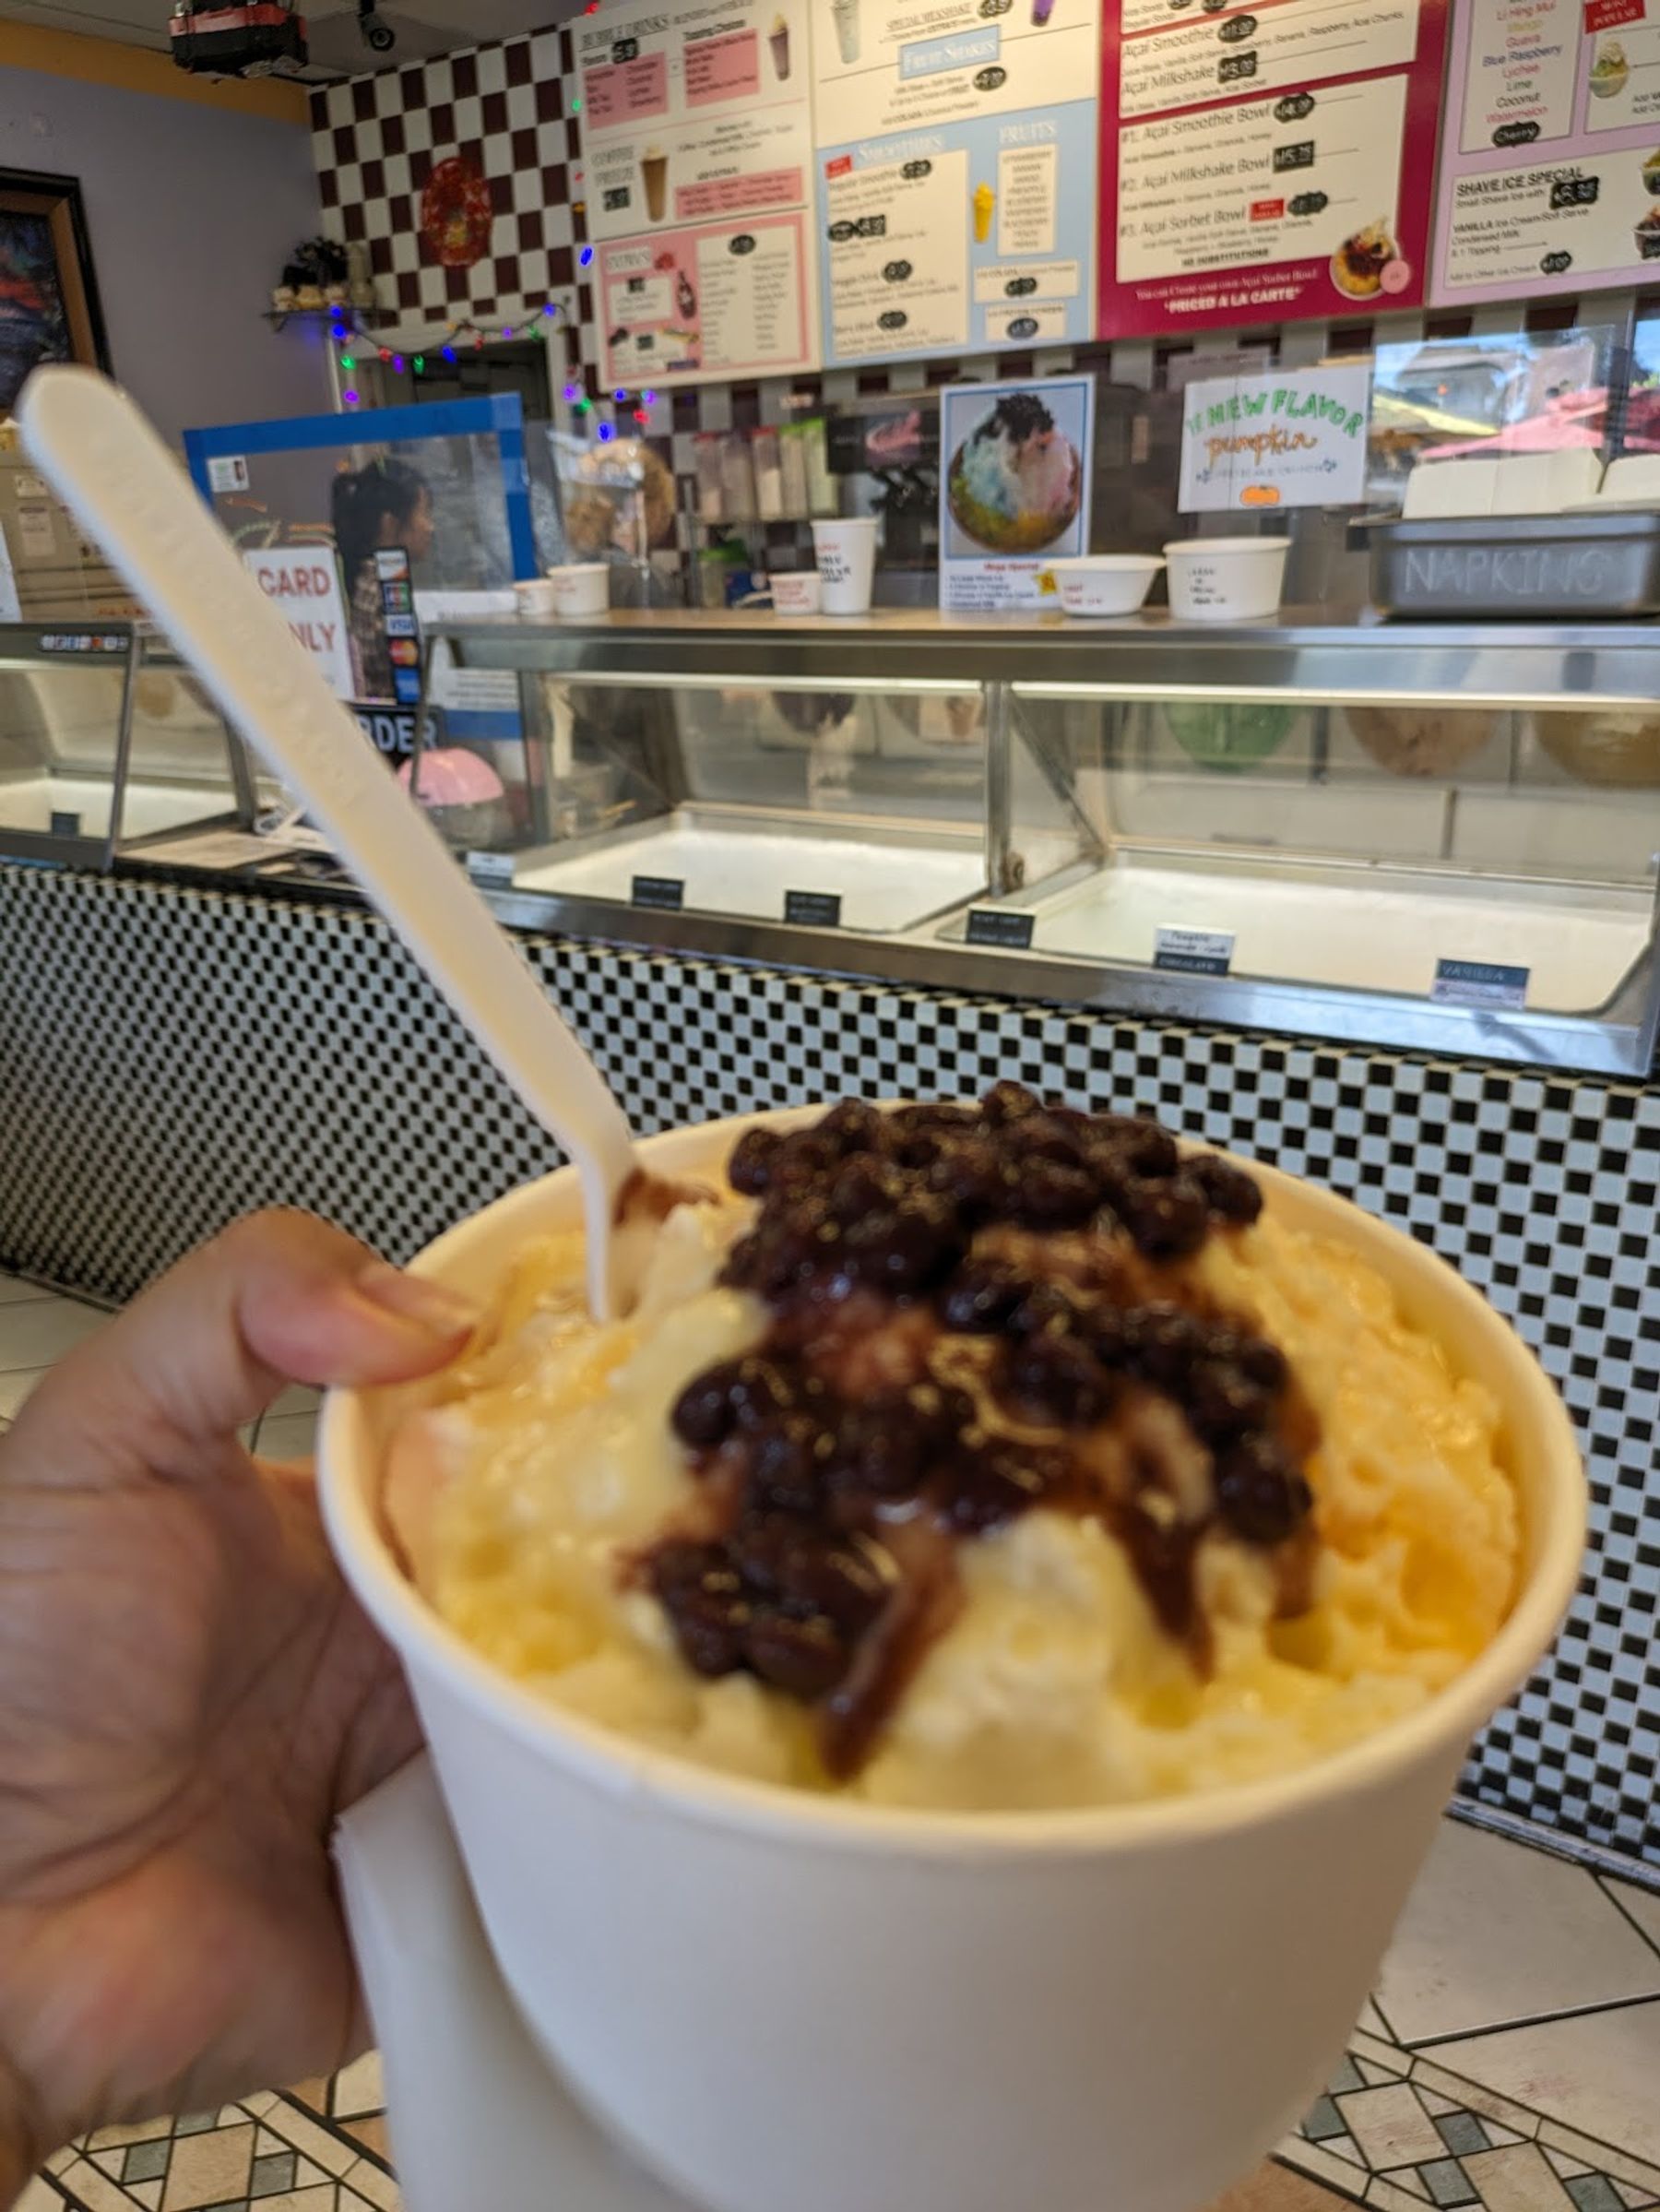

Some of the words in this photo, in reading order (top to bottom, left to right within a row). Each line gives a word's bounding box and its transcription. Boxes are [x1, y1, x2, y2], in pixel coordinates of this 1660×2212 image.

[1505, 34, 1542, 49] Guava
[1482, 54, 1506, 67] Blue
[1508, 44, 1563, 63] Raspberry
[1501, 64, 1541, 79] Lychee
[1506, 79, 1533, 92] Lime
[1495, 91, 1541, 109] Coconut
[1172, 111, 1235, 137] Smoothie
[1237, 103, 1271, 123] Bowl
[1485, 105, 1548, 125] Watermelon
[1171, 160, 1236, 183] Milkshake
[1237, 153, 1271, 174] Bowl
[1455, 177, 1501, 197] SHAVE
[1501, 175, 1525, 193] ICE
[1526, 166, 1584, 186] SPECIAL
[1481, 192, 1509, 207] Shave
[1169, 212, 1212, 232] Sorbet
[1213, 205, 1246, 224] Bowl
[1452, 219, 1493, 233] VANILLA
[1217, 294, 1229, 307] A
[1229, 291, 1250, 308] LA
[1207, 391, 1268, 428] NEW
[1272, 387, 1364, 440] FLAVOR
[1203, 422, 1318, 470] pumpkin
[257, 565, 331, 598] CARD
[287, 621, 337, 653] NLY
